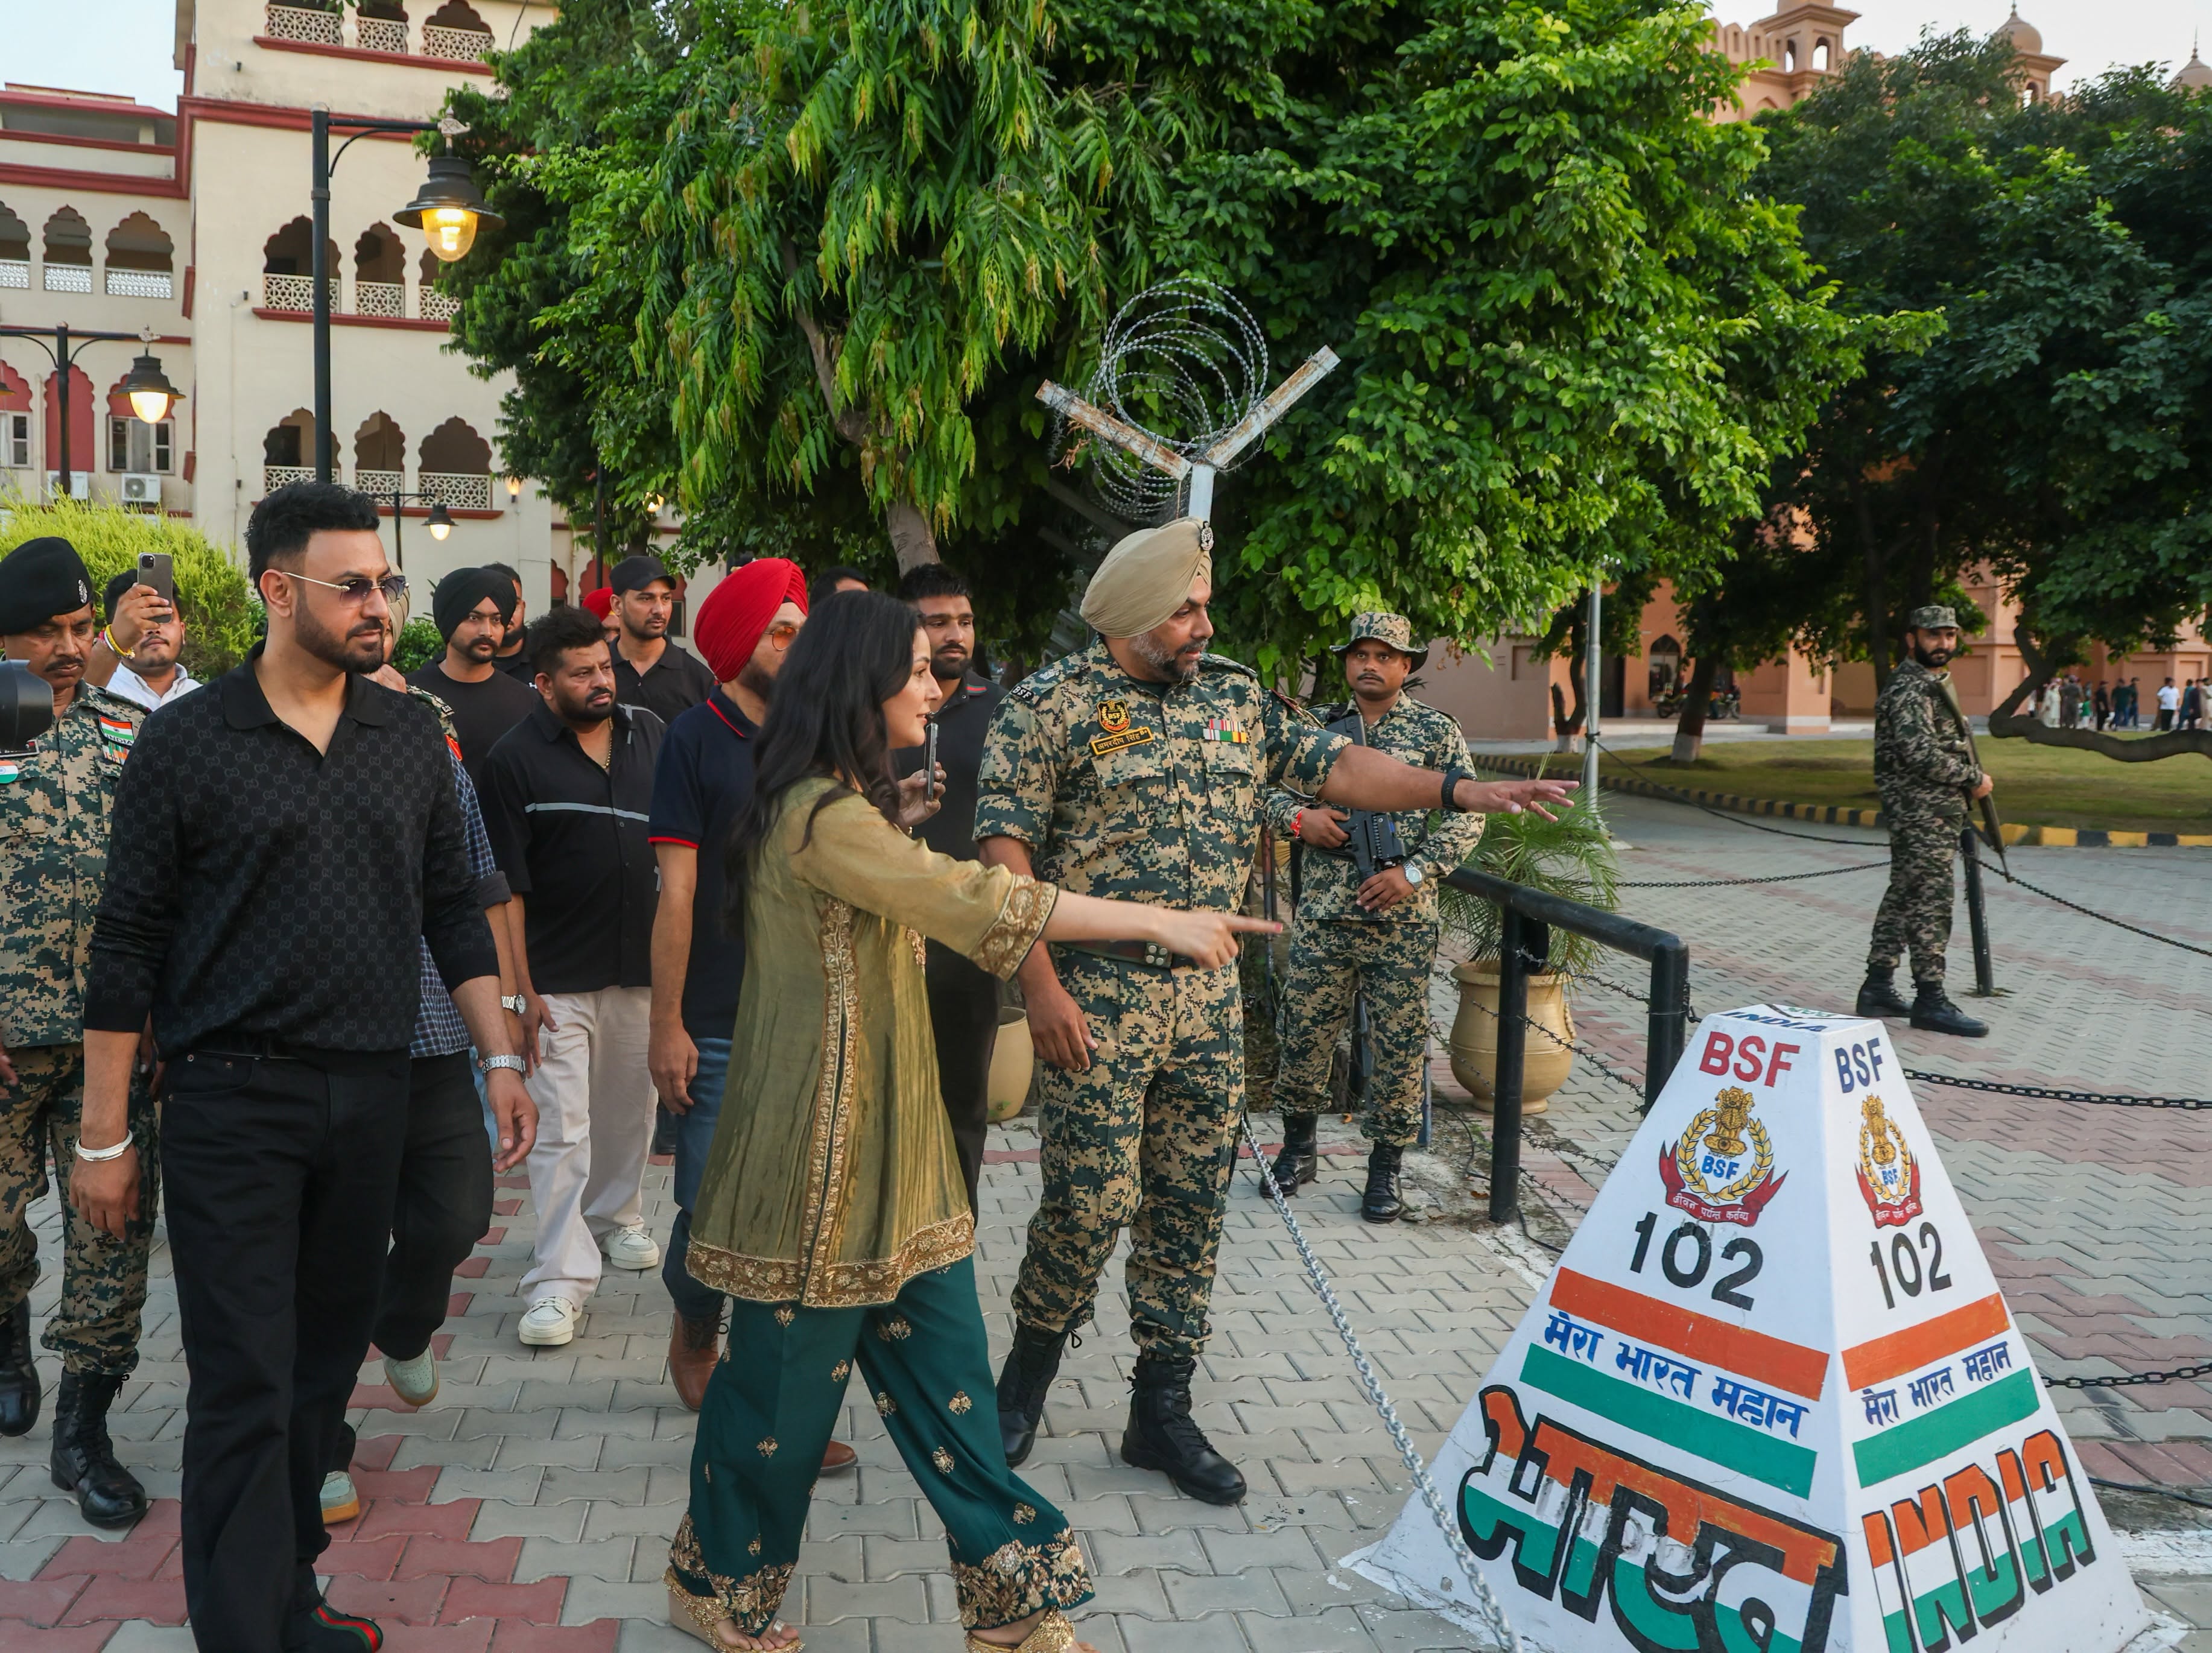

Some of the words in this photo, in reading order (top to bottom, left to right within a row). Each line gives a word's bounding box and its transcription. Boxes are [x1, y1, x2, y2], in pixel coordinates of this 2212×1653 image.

[1012, 686, 1032, 698] BSF
[106, 735, 133, 744] INDIA
[1098, 738, 1124, 749] अमरदीप
[1126, 733, 1141, 742] सिंह
[1720, 1011, 1828, 1032] INDIA
[1699, 1031, 1801, 1088] BSF
[1834, 1037, 1883, 1093] BSF
[1702, 1155, 1740, 1180] BSF
[1881, 1169, 1898, 1185] BSF
[1673, 1193, 1699, 1210] जीवन
[1630, 1211, 1763, 1311] 102
[1869, 1222, 1952, 1309] 102
[1544, 1311, 1605, 1363] मेरा
[1615, 1341, 1702, 1400] भारत
[1712, 1376, 1811, 1440] महान
[1860, 1388, 1900, 1426] मेरा
[1907, 1366, 1954, 1408] भारत
[1960, 1341, 2012, 1382] महान
[1457, 1385, 1849, 1653] भारत
[1862, 1429, 2096, 1653] INDIA
